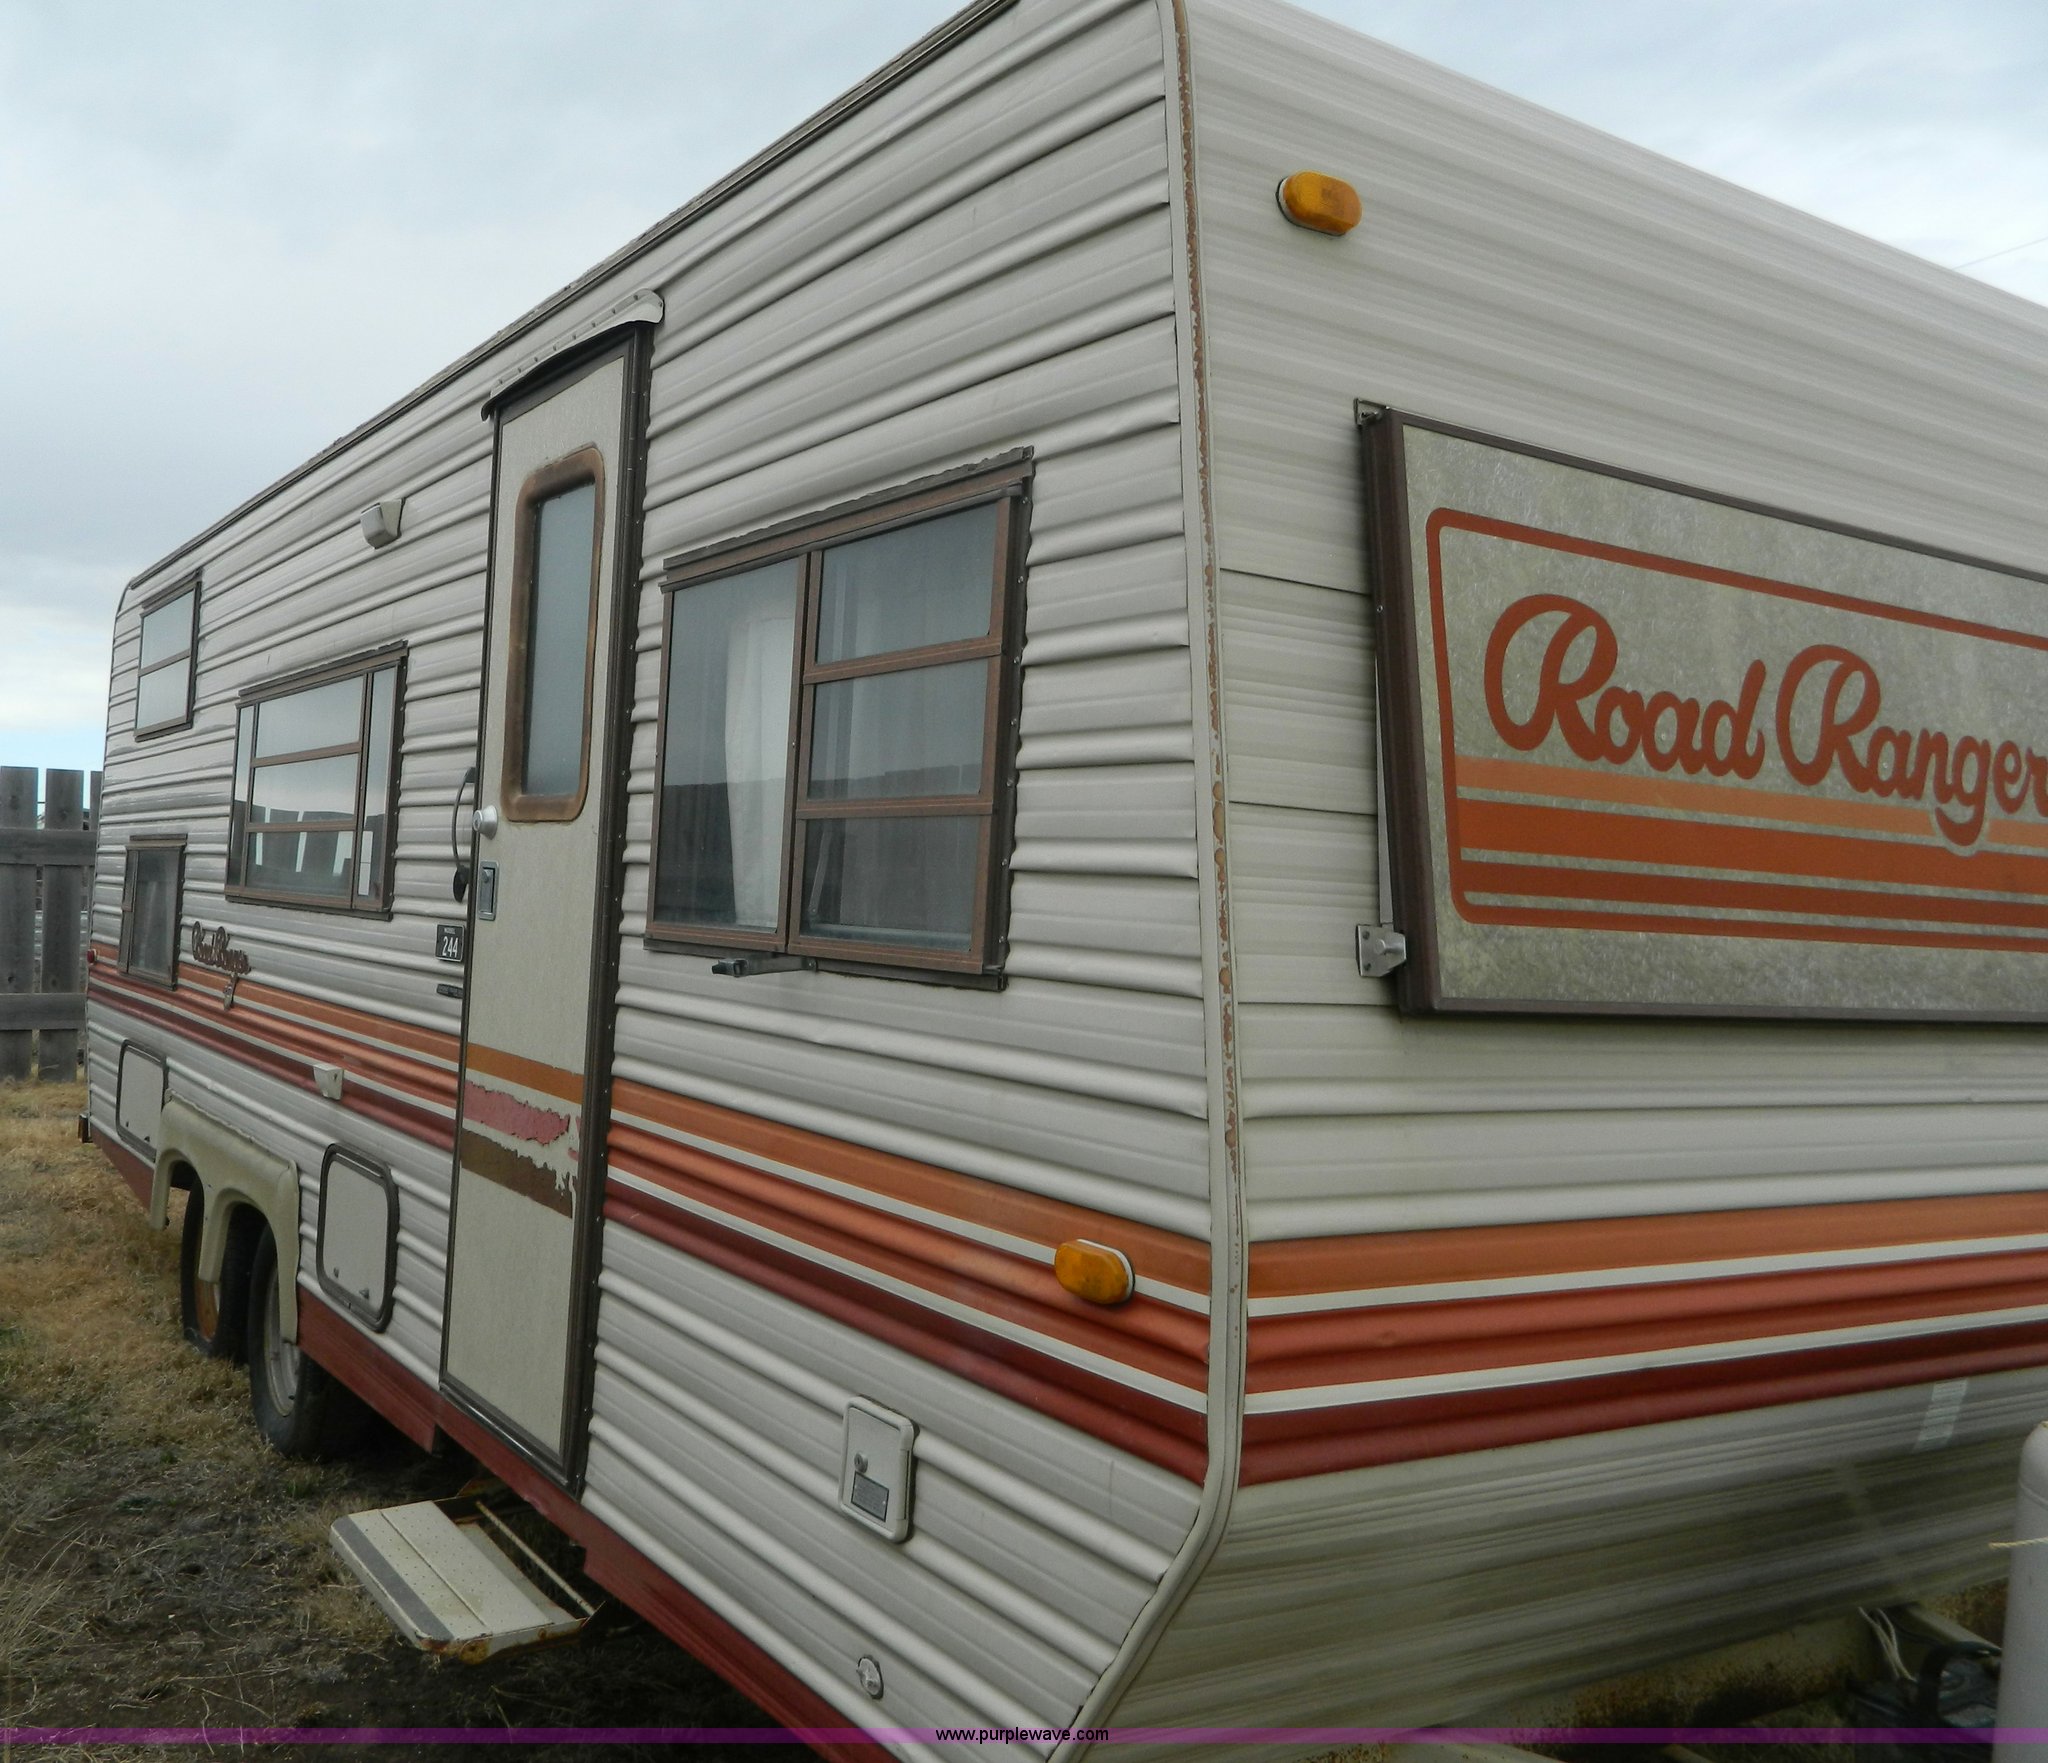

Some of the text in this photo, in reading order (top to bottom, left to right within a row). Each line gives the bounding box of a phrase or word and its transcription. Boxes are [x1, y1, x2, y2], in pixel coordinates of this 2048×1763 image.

[1484, 593, 2048, 847] Road Ranger
[442, 936, 459, 958] 244
